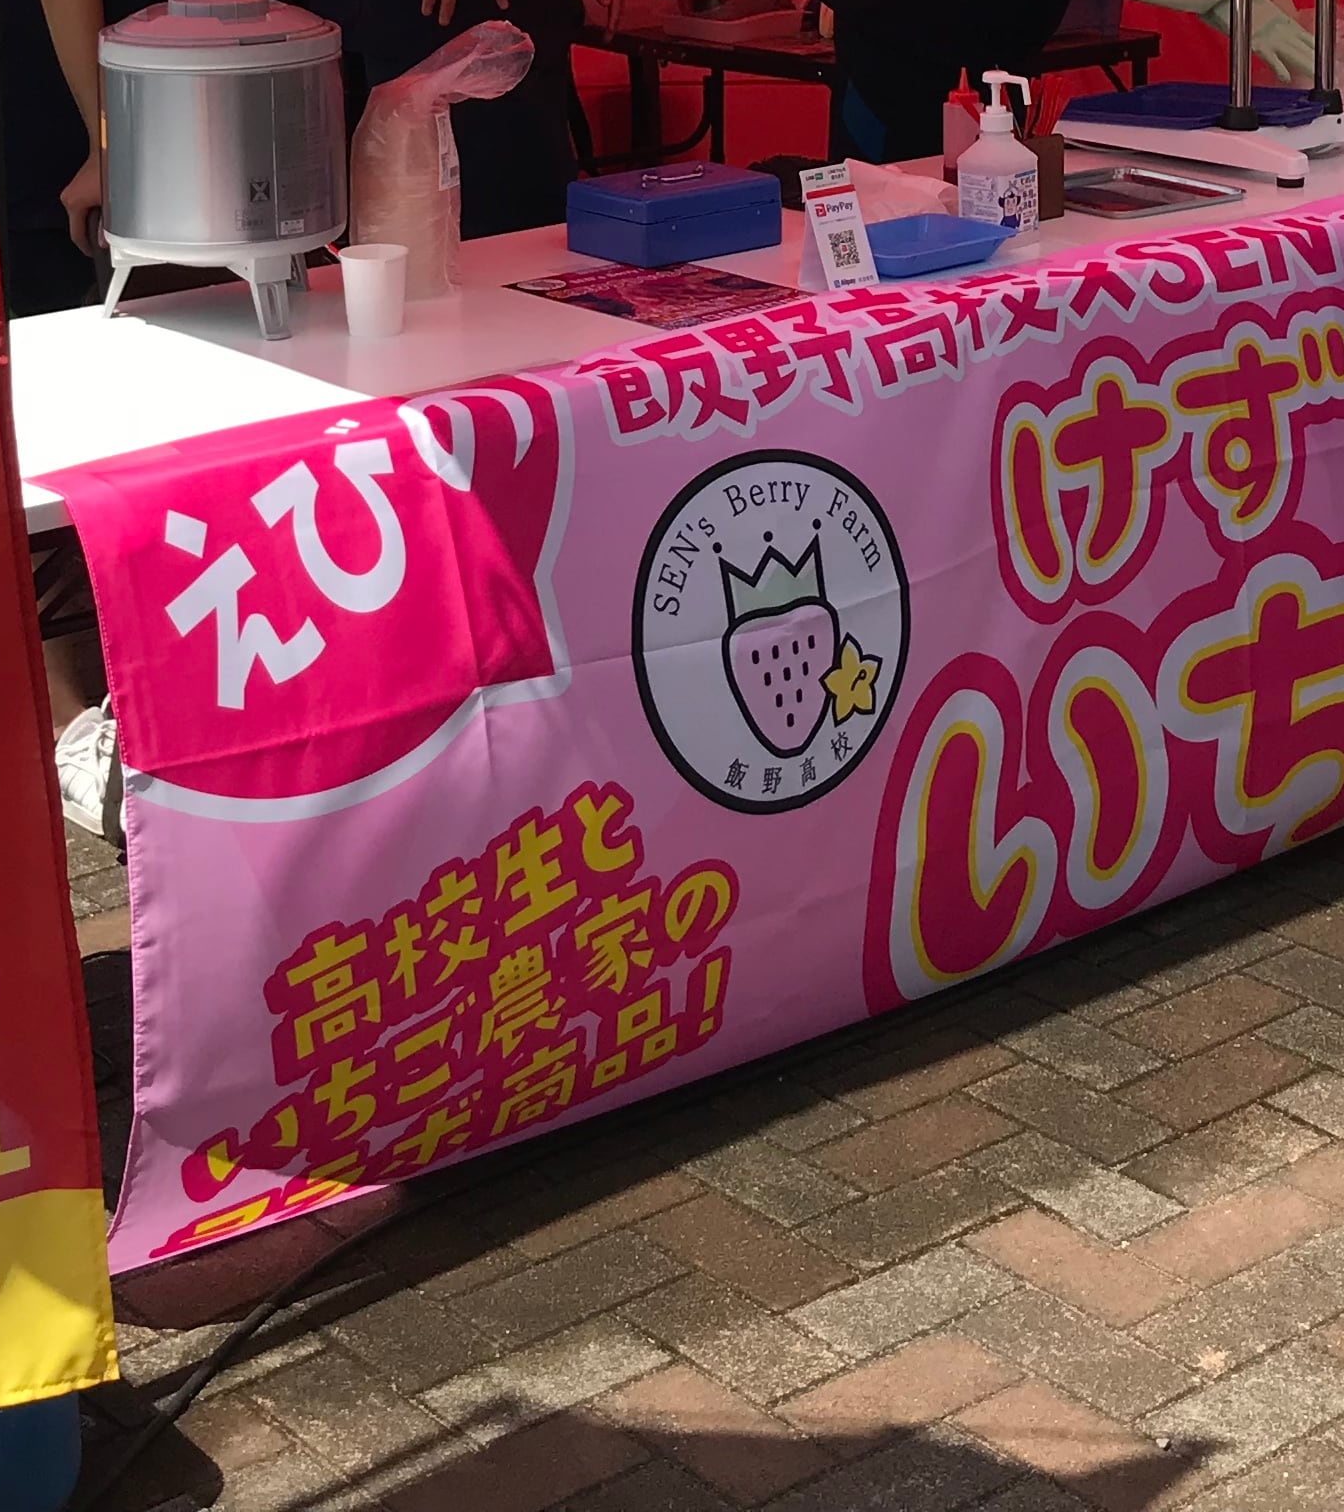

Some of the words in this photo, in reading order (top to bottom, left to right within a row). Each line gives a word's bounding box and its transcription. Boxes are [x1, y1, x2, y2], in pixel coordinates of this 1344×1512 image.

[825, 201, 854, 214] PayPay
[165, 375, 537, 710] えびの
[651, 514, 717, 618] SEN's
[721, 477, 813, 519] Berry
[825, 488, 884, 575] Farm
[722, 728, 856, 795] 飯野高校
[207, 868, 732, 1181] いちご農家の
[286, 793, 635, 1058] 高校生と
